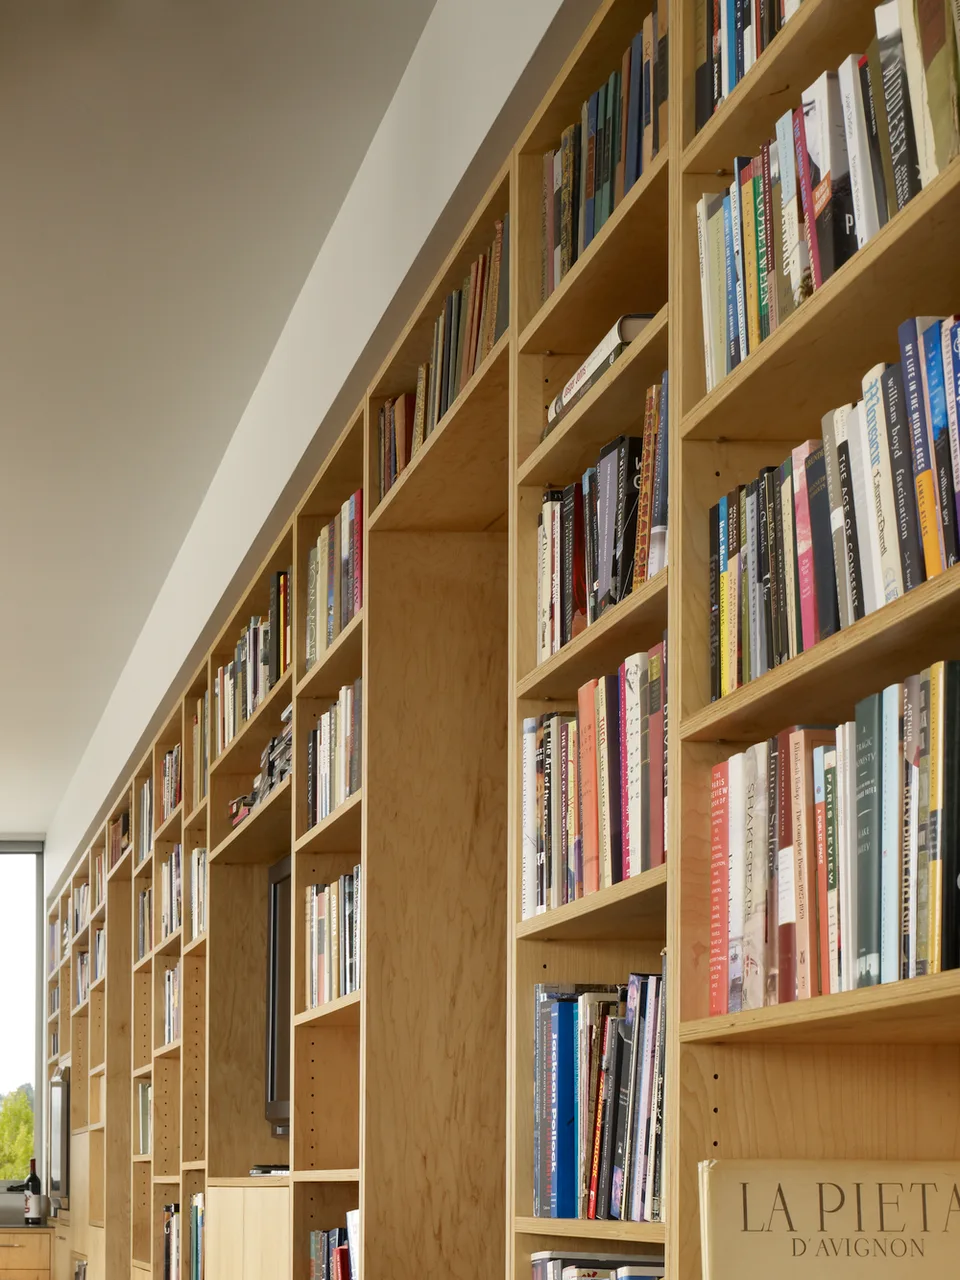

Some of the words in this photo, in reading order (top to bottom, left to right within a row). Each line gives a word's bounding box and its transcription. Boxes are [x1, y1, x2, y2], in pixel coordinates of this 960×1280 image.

[882, 58, 908, 166] MIDDLESEX
[900, 164, 910, 200] JEFFREY
[905, 343, 912, 358] MY
[887, 376, 899, 424] william
[908, 381, 915, 392] IN
[910, 394, 918, 411] THE
[644, 396, 654, 486] MICHAEL
[891, 427, 903, 460] boyd
[911, 412, 921, 445] MIDDLE
[950, 420, 958, 460] WALKING
[824, 434, 836, 509] SHIPWRECK
[915, 447, 924, 471] AGES
[895, 468, 909, 540] fascination
[637, 492, 649, 578] CHABON
[758, 511, 767, 554] Chatwin
[845, 518, 852, 538] OF
[846, 542, 858, 608] CONSENT
[543, 776, 551, 788] of
[744, 783, 755, 924] SHAKESPEARE
[768, 812, 778, 870] Salter
[595, 1076, 604, 1126] JACKSON
[592, 1128, 602, 1178] POLLOCK
[740, 1182, 798, 1233] LA
[792, 1238, 925, 1258] D'AVIGNON
